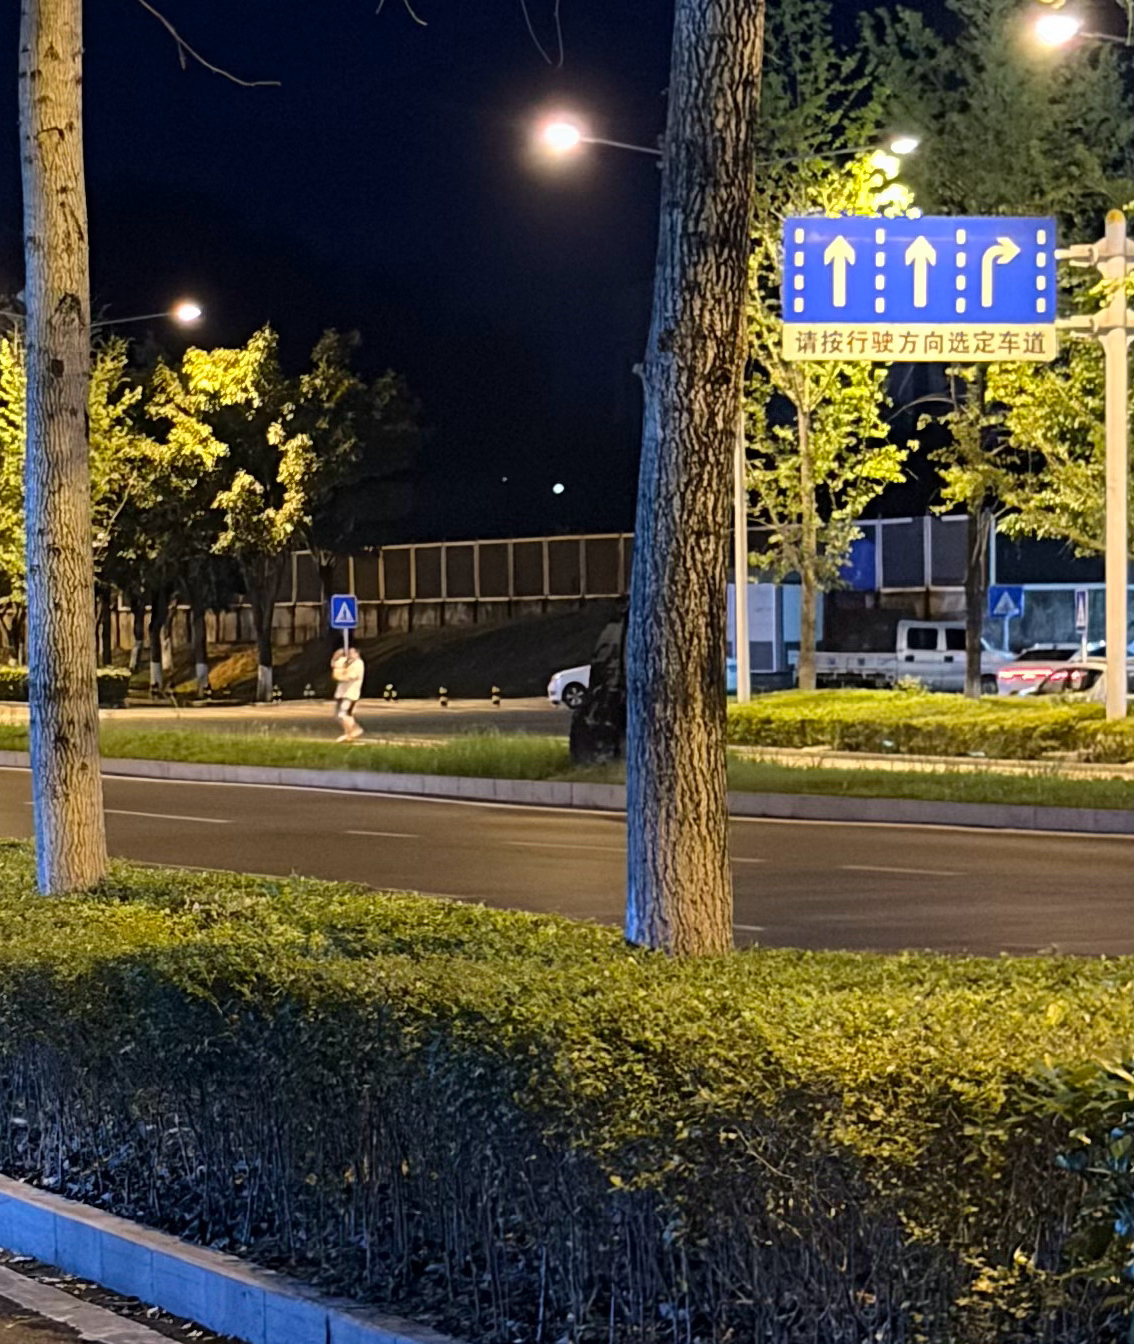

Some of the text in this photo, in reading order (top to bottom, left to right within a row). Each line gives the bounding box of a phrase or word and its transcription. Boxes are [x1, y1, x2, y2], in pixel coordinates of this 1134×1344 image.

[795, 330, 1046, 354] 请按行驶方向选定车道
